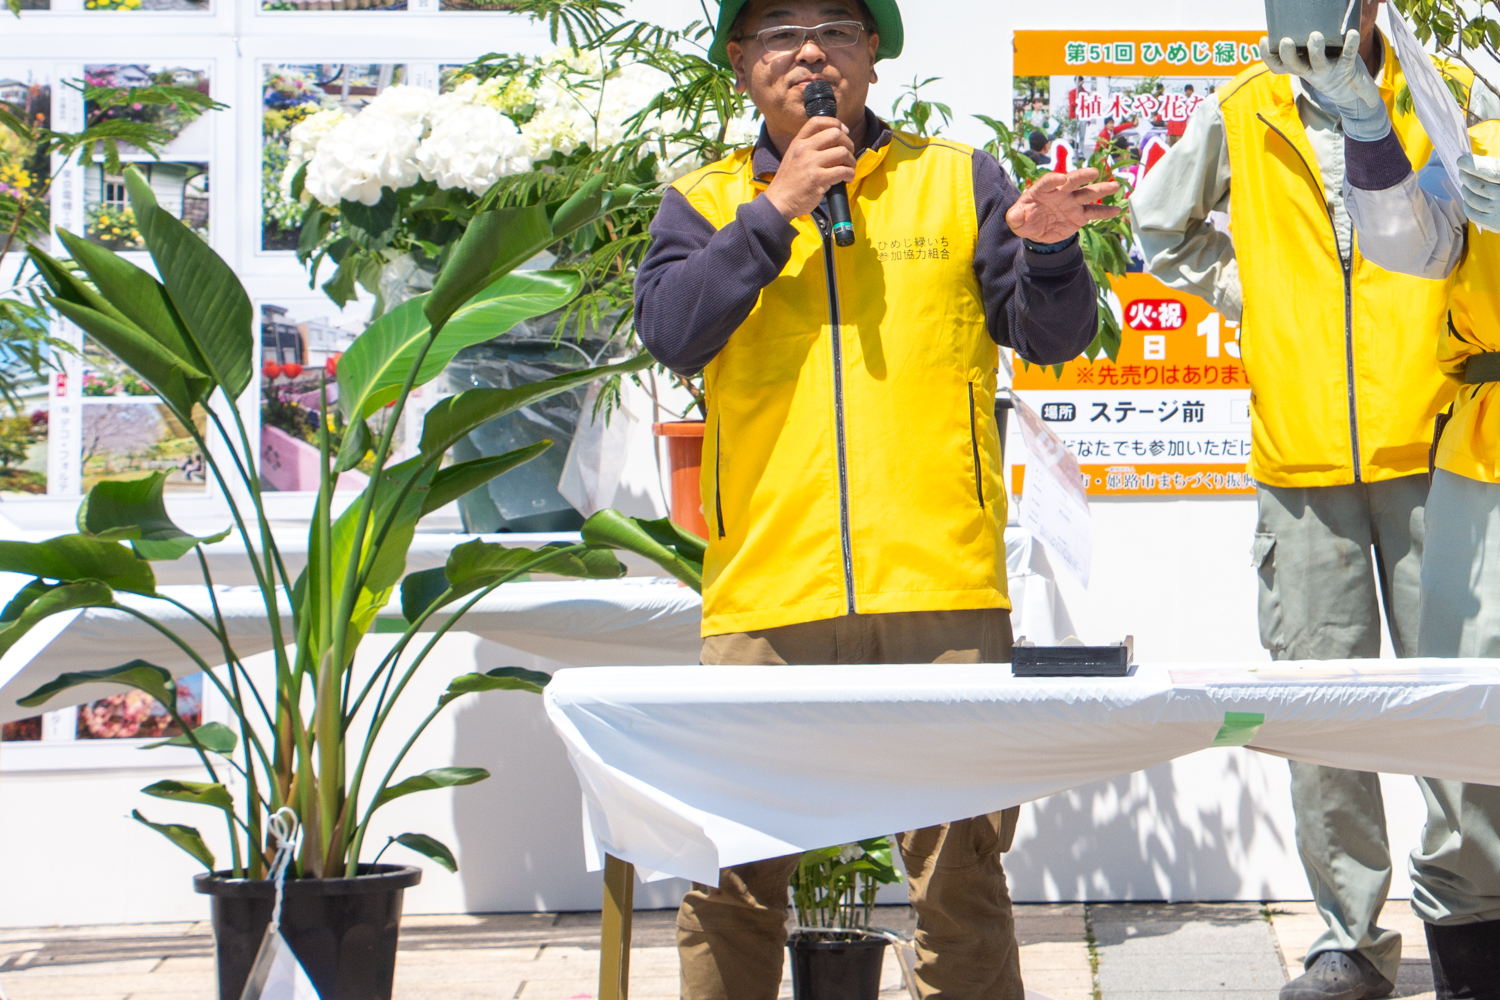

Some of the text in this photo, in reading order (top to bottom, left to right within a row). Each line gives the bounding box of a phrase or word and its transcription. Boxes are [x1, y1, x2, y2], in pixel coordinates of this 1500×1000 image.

[1066, 42, 1135, 64] 第51回
[877, 236, 949, 251] ひめじ緑いち
[877, 248, 950, 262] 参加協力組合
[1129, 302, 1182, 328] 火・祝
[1143, 335, 1166, 360] 日
[1043, 400, 1205, 423] 場所 ステージ前
